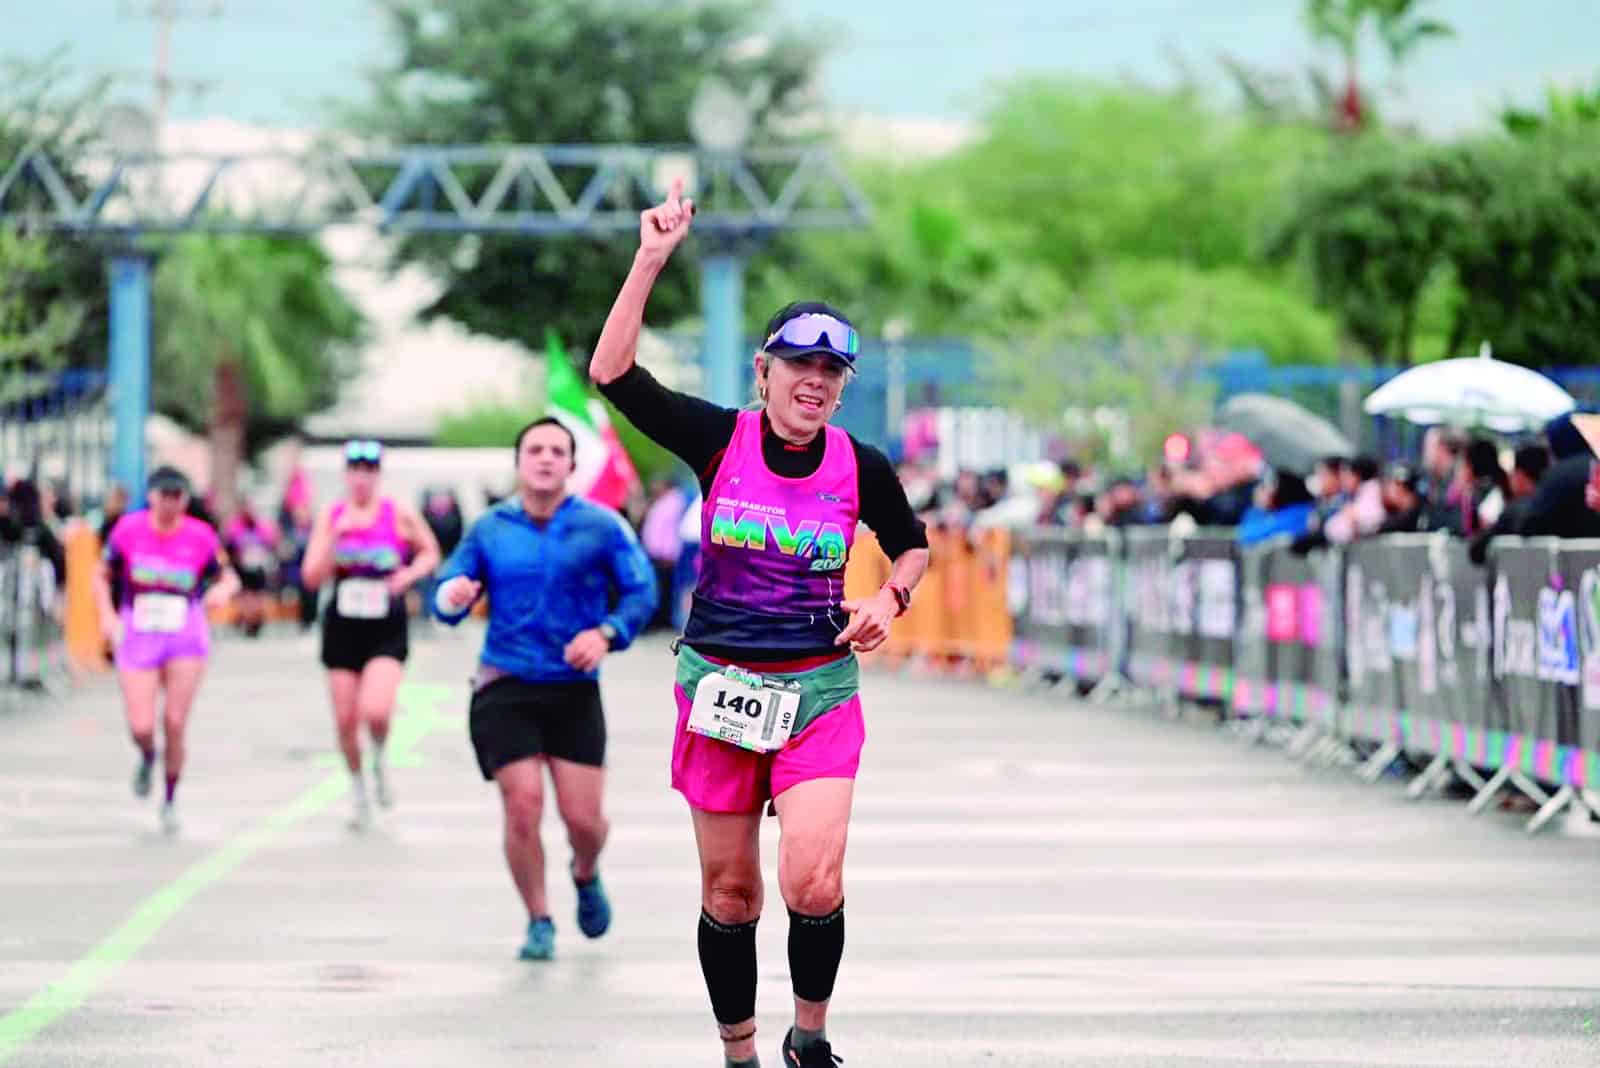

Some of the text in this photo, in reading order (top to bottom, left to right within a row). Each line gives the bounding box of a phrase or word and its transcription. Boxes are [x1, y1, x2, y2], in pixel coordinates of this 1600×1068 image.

[740, 500, 786, 515] MARATON
[711, 506, 847, 560] MVA
[713, 690, 762, 718] 140
[780, 712, 792, 731] 140
